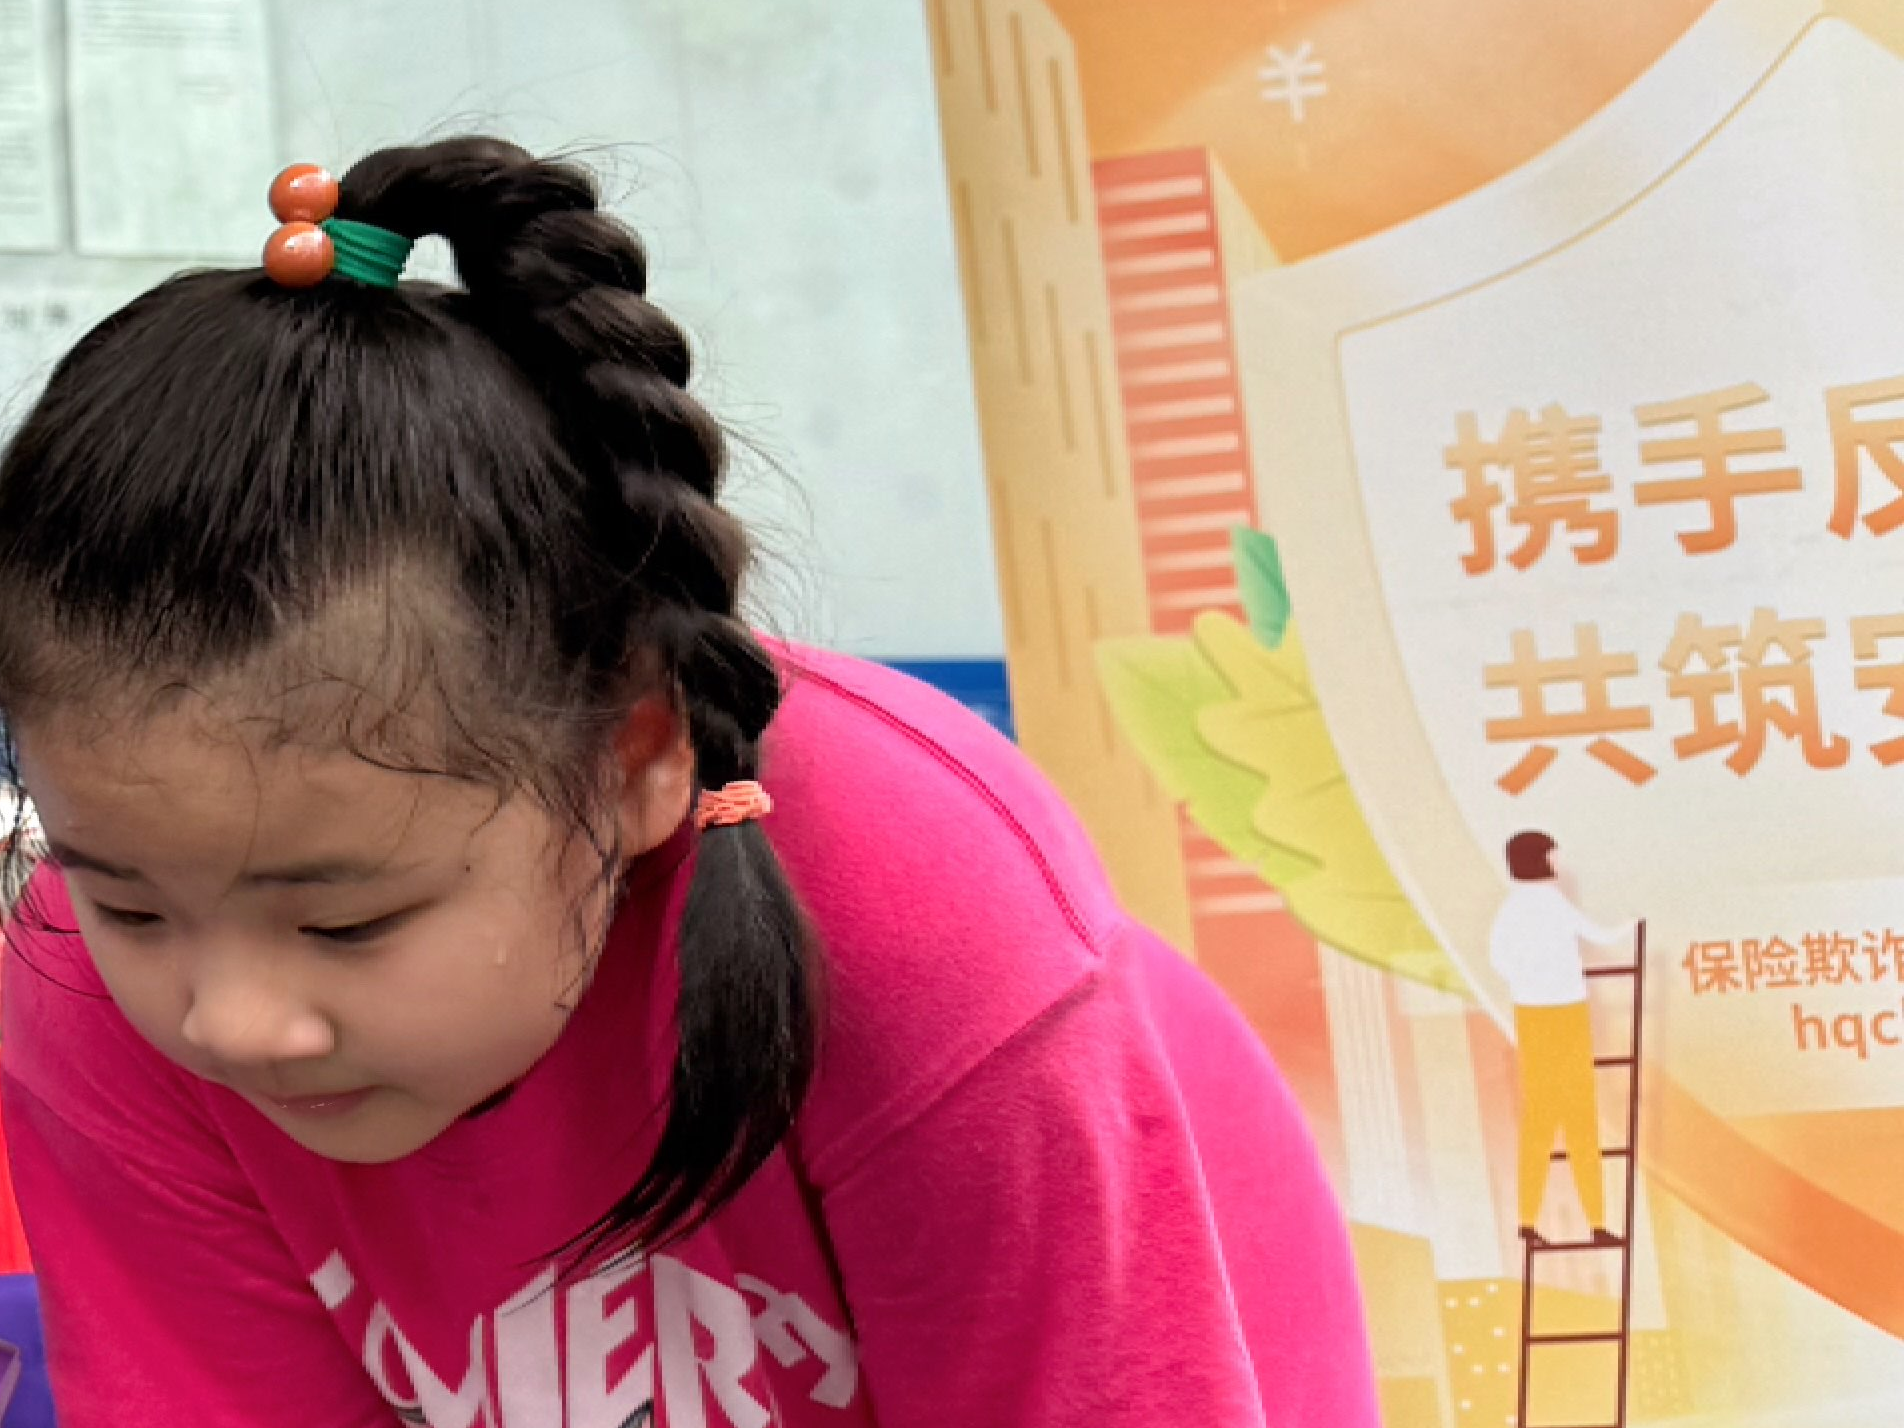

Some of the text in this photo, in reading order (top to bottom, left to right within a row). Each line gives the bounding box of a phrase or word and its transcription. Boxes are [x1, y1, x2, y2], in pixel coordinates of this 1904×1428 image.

[1682, 925, 1904, 996] 保险欺诈
[1789, 996, 1904, 1061] hqc
